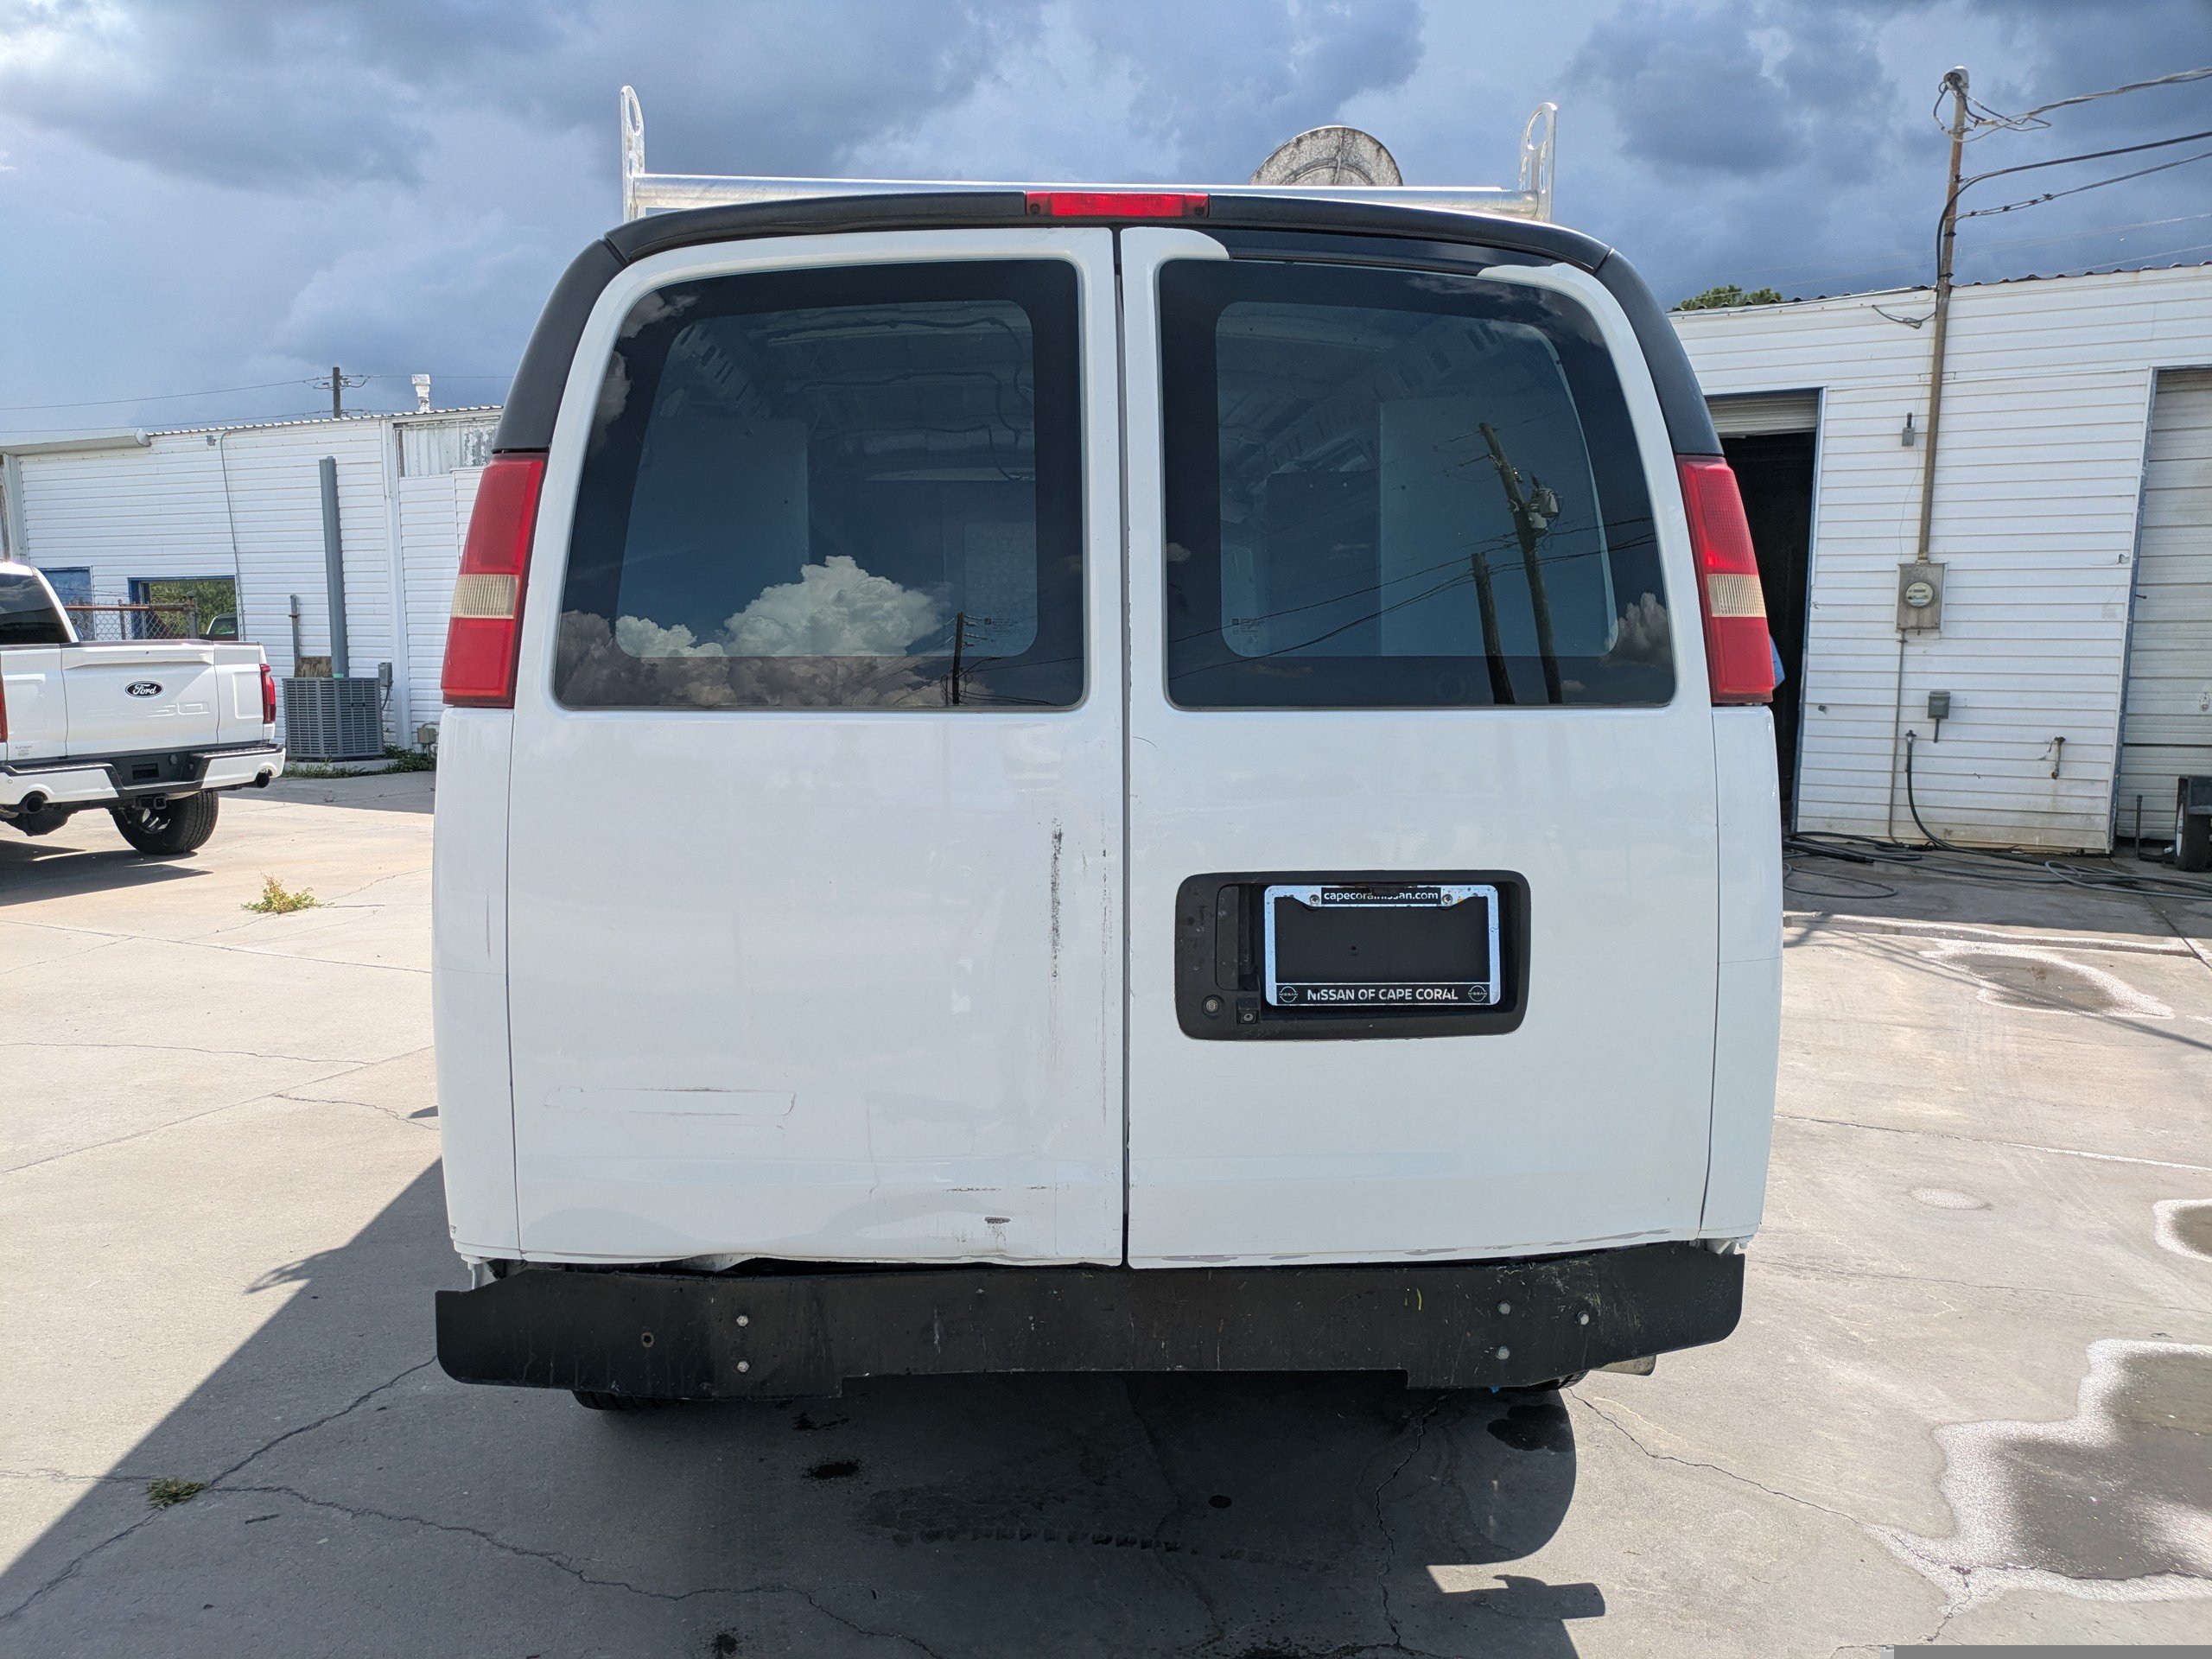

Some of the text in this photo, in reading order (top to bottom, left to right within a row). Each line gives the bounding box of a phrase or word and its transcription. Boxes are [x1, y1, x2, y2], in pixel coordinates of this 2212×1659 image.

[132, 683, 156, 695] Ford
[1324, 890, 1439, 901] capecoraan.com
[1307, 988, 1459, 1001] NISSAN OF CAPE CORAL
